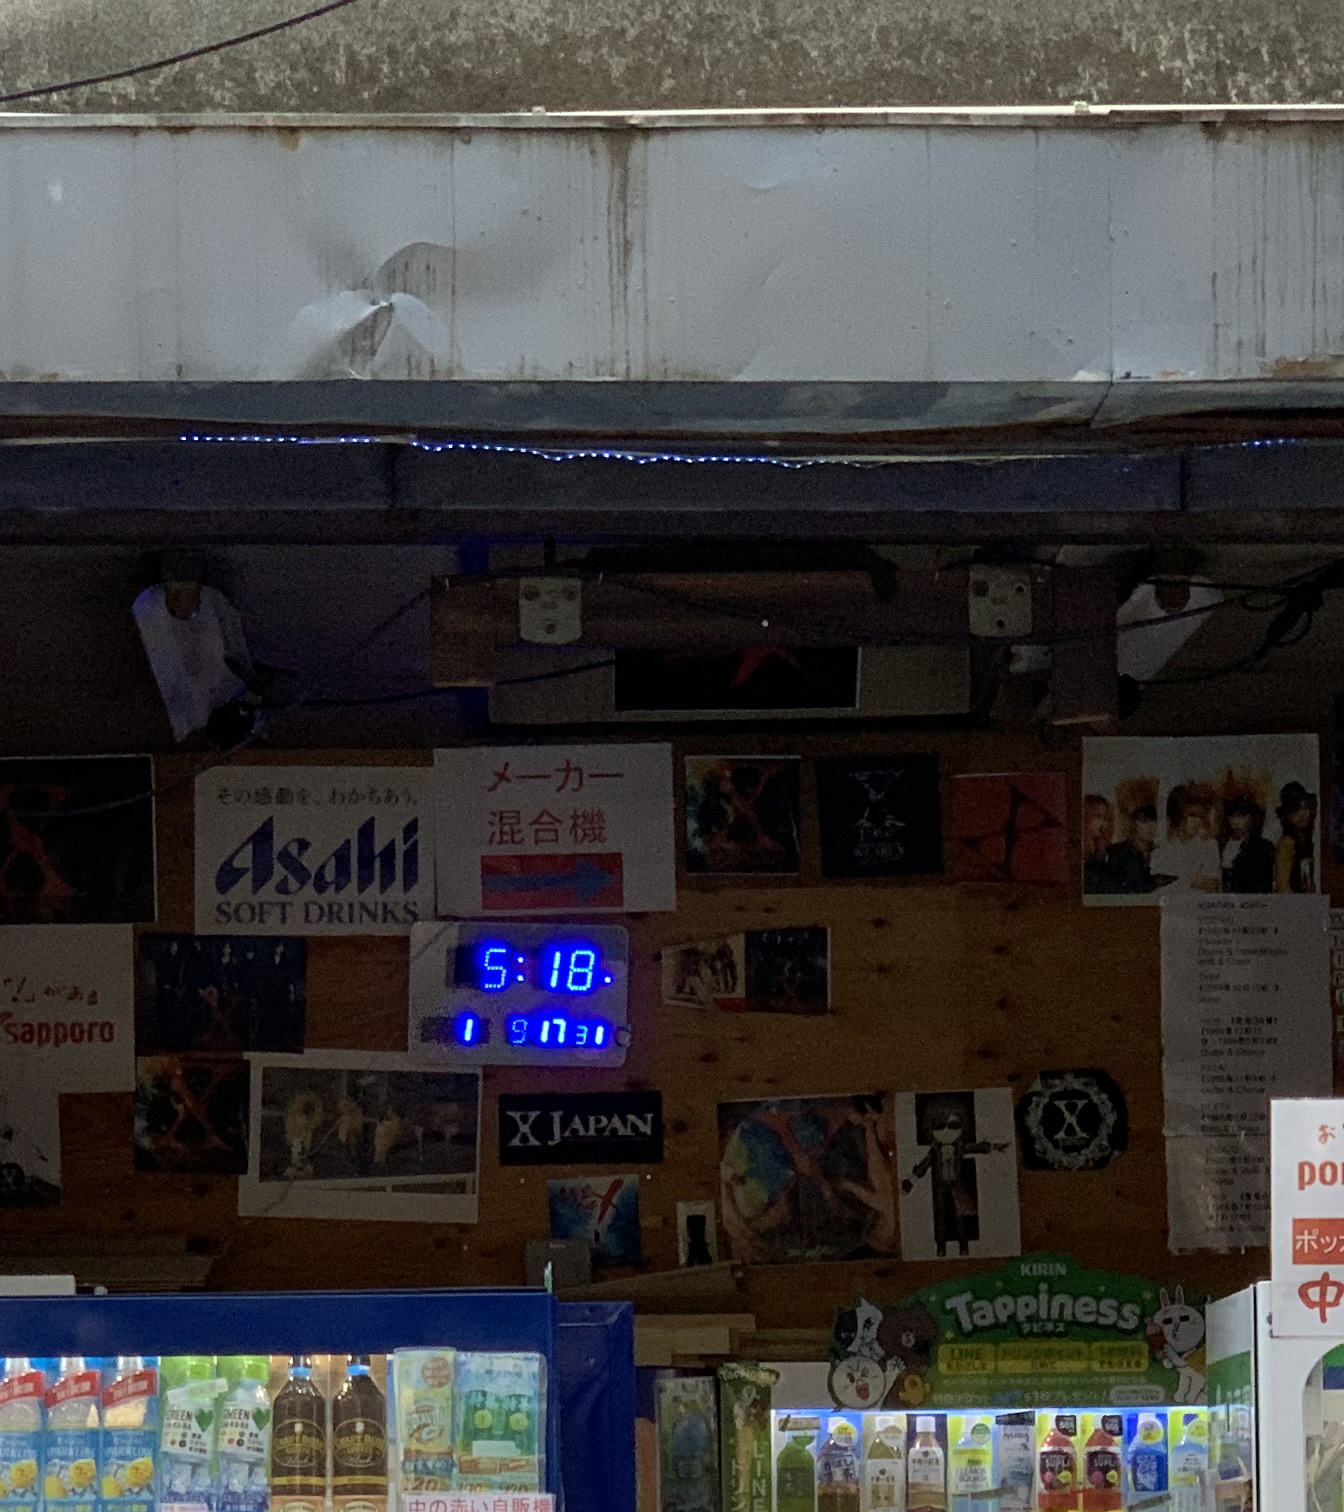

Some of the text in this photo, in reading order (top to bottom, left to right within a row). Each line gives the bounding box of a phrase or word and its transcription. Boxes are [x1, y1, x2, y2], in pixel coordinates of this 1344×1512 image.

[487, 758, 626, 795] メーカー
[486, 810, 608, 846] 混合機
[214, 815, 420, 896] Asahi
[214, 901, 420, 925] SOFT DRINKS
[504, 1108, 655, 1148] X JAPAN
[1020, 1263, 1068, 1277] KIRIN
[944, 1282, 1142, 1334] Tappiness
